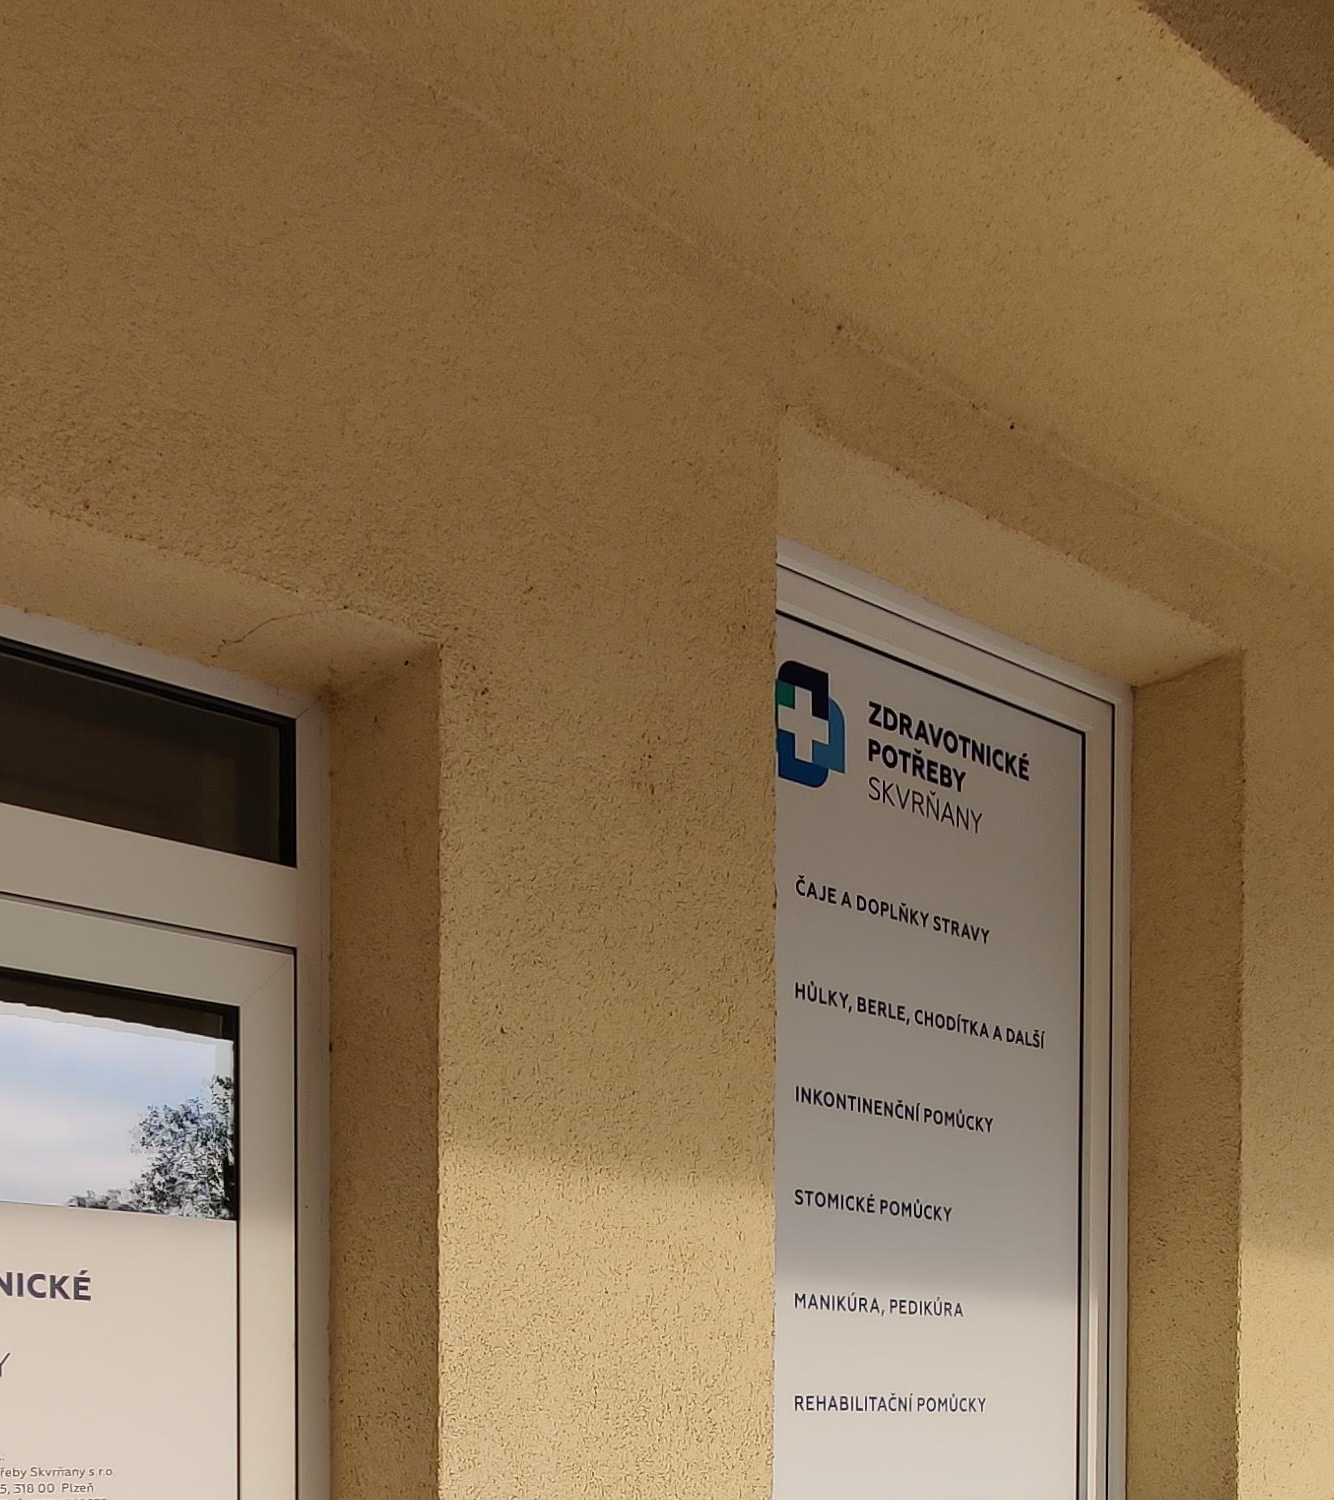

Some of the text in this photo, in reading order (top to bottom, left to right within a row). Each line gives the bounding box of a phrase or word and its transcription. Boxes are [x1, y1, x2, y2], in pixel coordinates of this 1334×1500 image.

[868, 701, 1030, 781] ZDRAVOTNICKÉ
[868, 738, 966, 792] POTŘEBY
[868, 776, 983, 834] SKVRŇANY
[796, 875, 989, 944] ČAJE A DOPLŇKY STRAVY
[795, 981, 1045, 1049] HŮLKY, BERLE, CHODÍTKA A DALŠÍ
[796, 1086, 993, 1132] INKONTINENČNÍ POMŮCKY
[795, 1190, 951, 1222] STOMICKÉ POMŮCKY
[795, 1292, 964, 1317] MANIKÚRA, PEDIKÚRA
[794, 1392, 986, 1413] REHABILITAČNÍ POMŮCKY
[37, 1483, 55, 1494] 00
[61, 1482, 94, 1493] Plzeň
